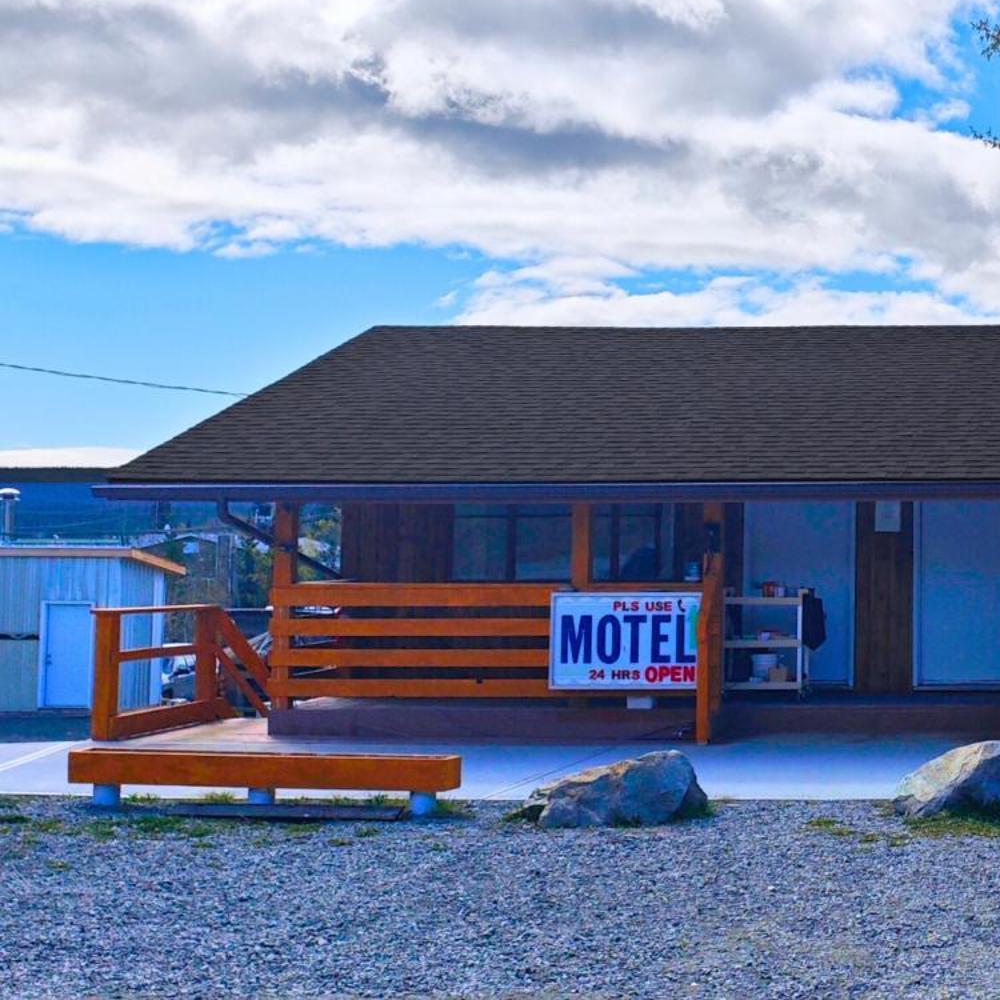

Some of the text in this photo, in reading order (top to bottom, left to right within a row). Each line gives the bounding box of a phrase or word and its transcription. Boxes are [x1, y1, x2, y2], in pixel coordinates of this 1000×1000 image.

[613, 601, 672, 612] PLS USE
[560, 614, 696, 665] MOTEL
[588, 666, 696, 683] 24 HRS OPEN
